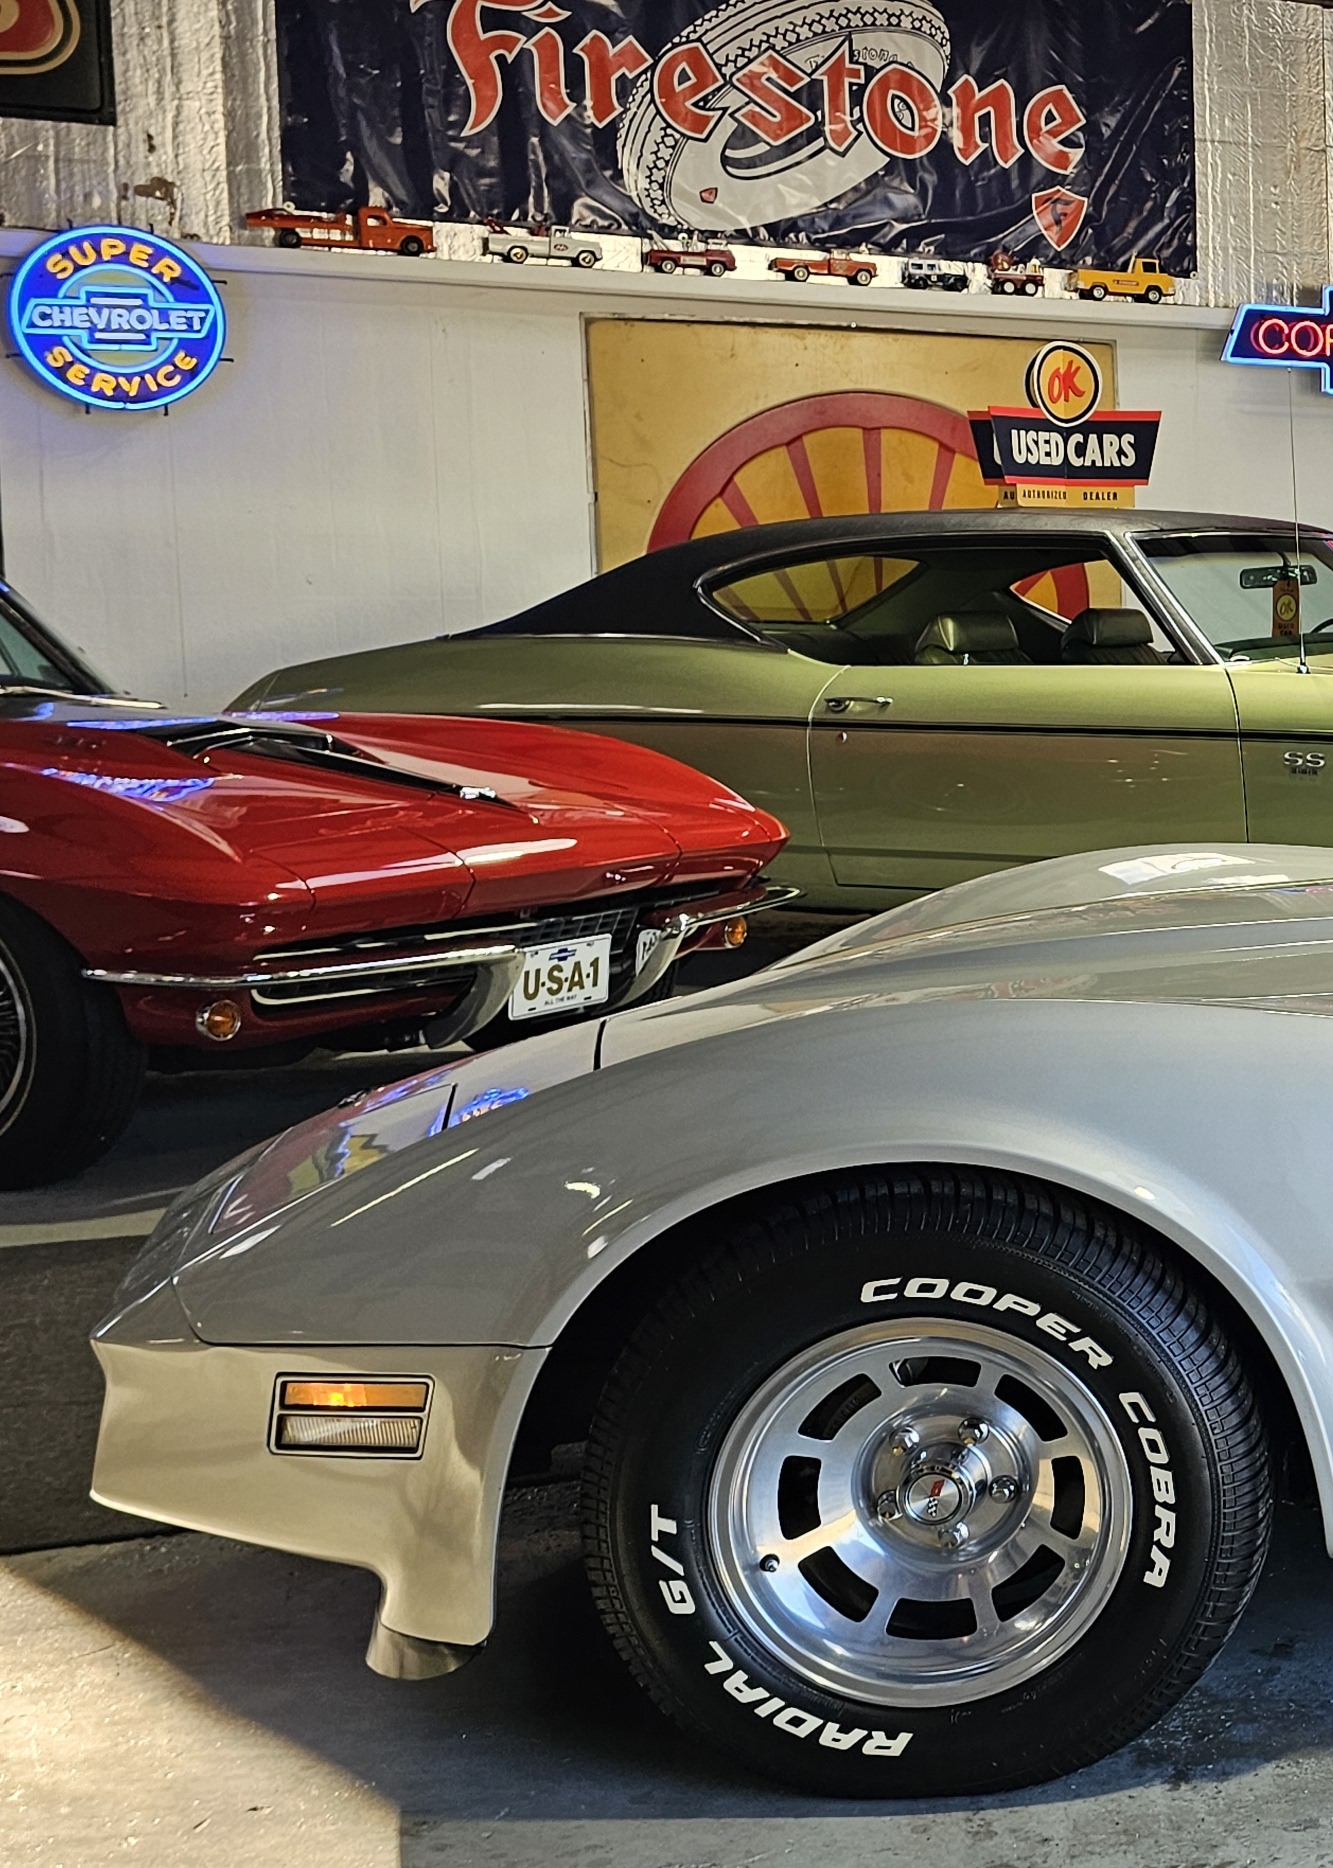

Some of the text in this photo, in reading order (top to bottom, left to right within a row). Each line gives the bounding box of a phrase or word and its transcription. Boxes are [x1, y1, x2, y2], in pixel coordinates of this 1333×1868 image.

[412, 0, 1087, 176] Firestone
[46, 238, 182, 283] SUPER
[31, 305, 206, 331] CHEVROLET
[46, 346, 198, 397] SERVICE
[1047, 359, 1086, 405] OK
[1011, 428, 1065, 466] USED
[1067, 433, 1136, 468] CARS
[1022, 489, 1067, 501] AUTHORIZED
[1083, 491, 1119, 501] DEALER
[1283, 750, 1326, 768] SS
[555, 996, 566, 1004] THE
[860, 1276, 1178, 1588] COOPER COBRA
[649, 1503, 914, 1757] RADIAL G/T
